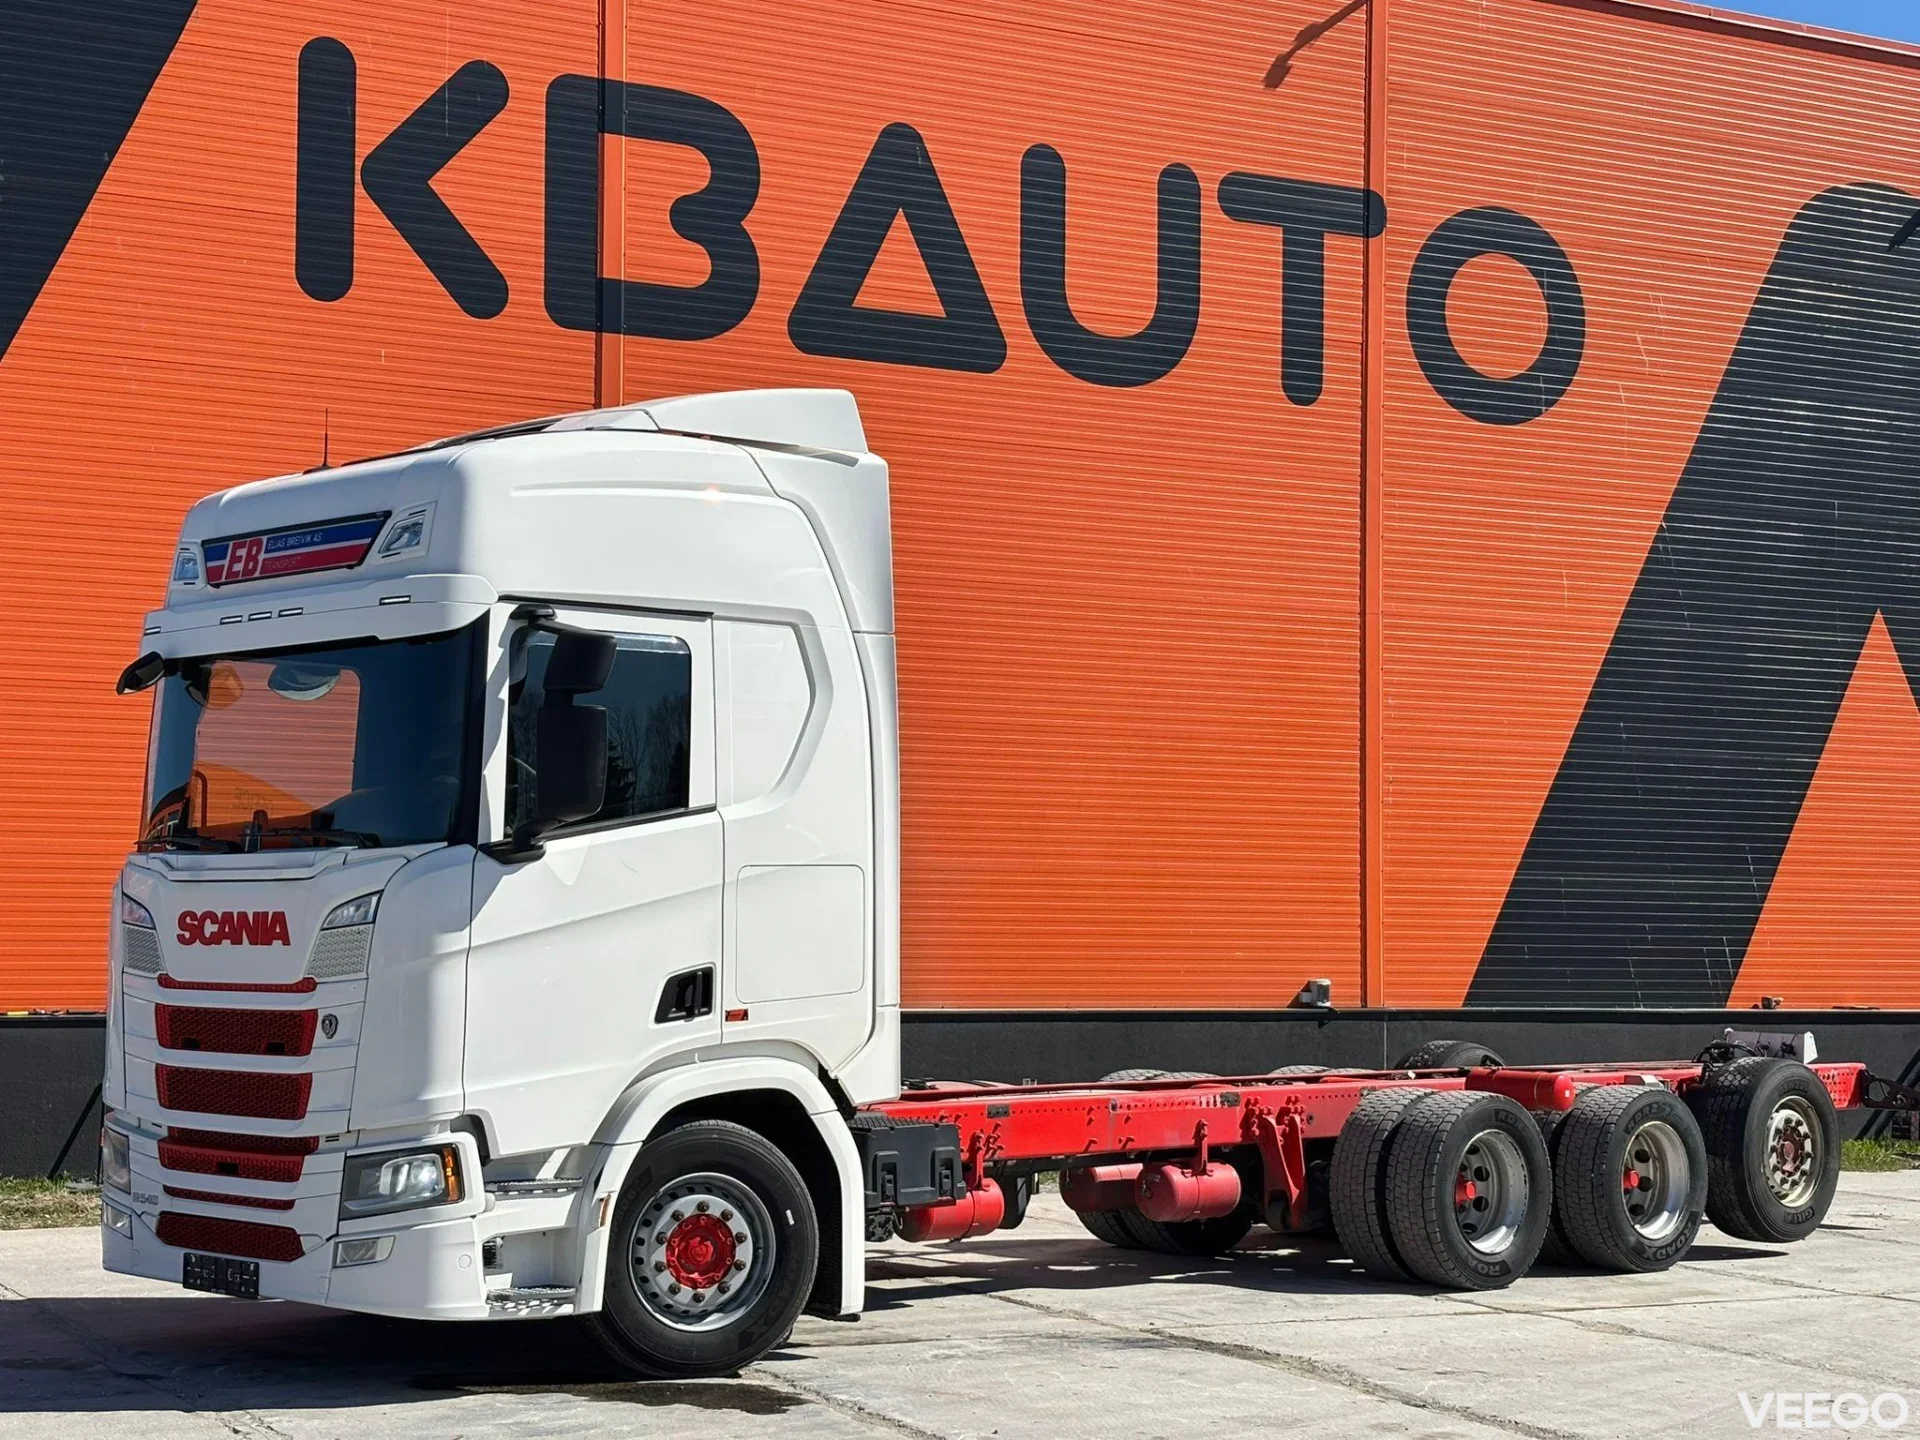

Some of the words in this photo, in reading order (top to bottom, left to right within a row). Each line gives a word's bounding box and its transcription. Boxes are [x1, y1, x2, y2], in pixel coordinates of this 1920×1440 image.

[295, 36, 1586, 426] KBAUTO
[313, 532, 323, 541] AS
[224, 536, 264, 581] EB
[176, 910, 291, 946] SCANIA
[1643, 1221, 1693, 1261] ROADX
